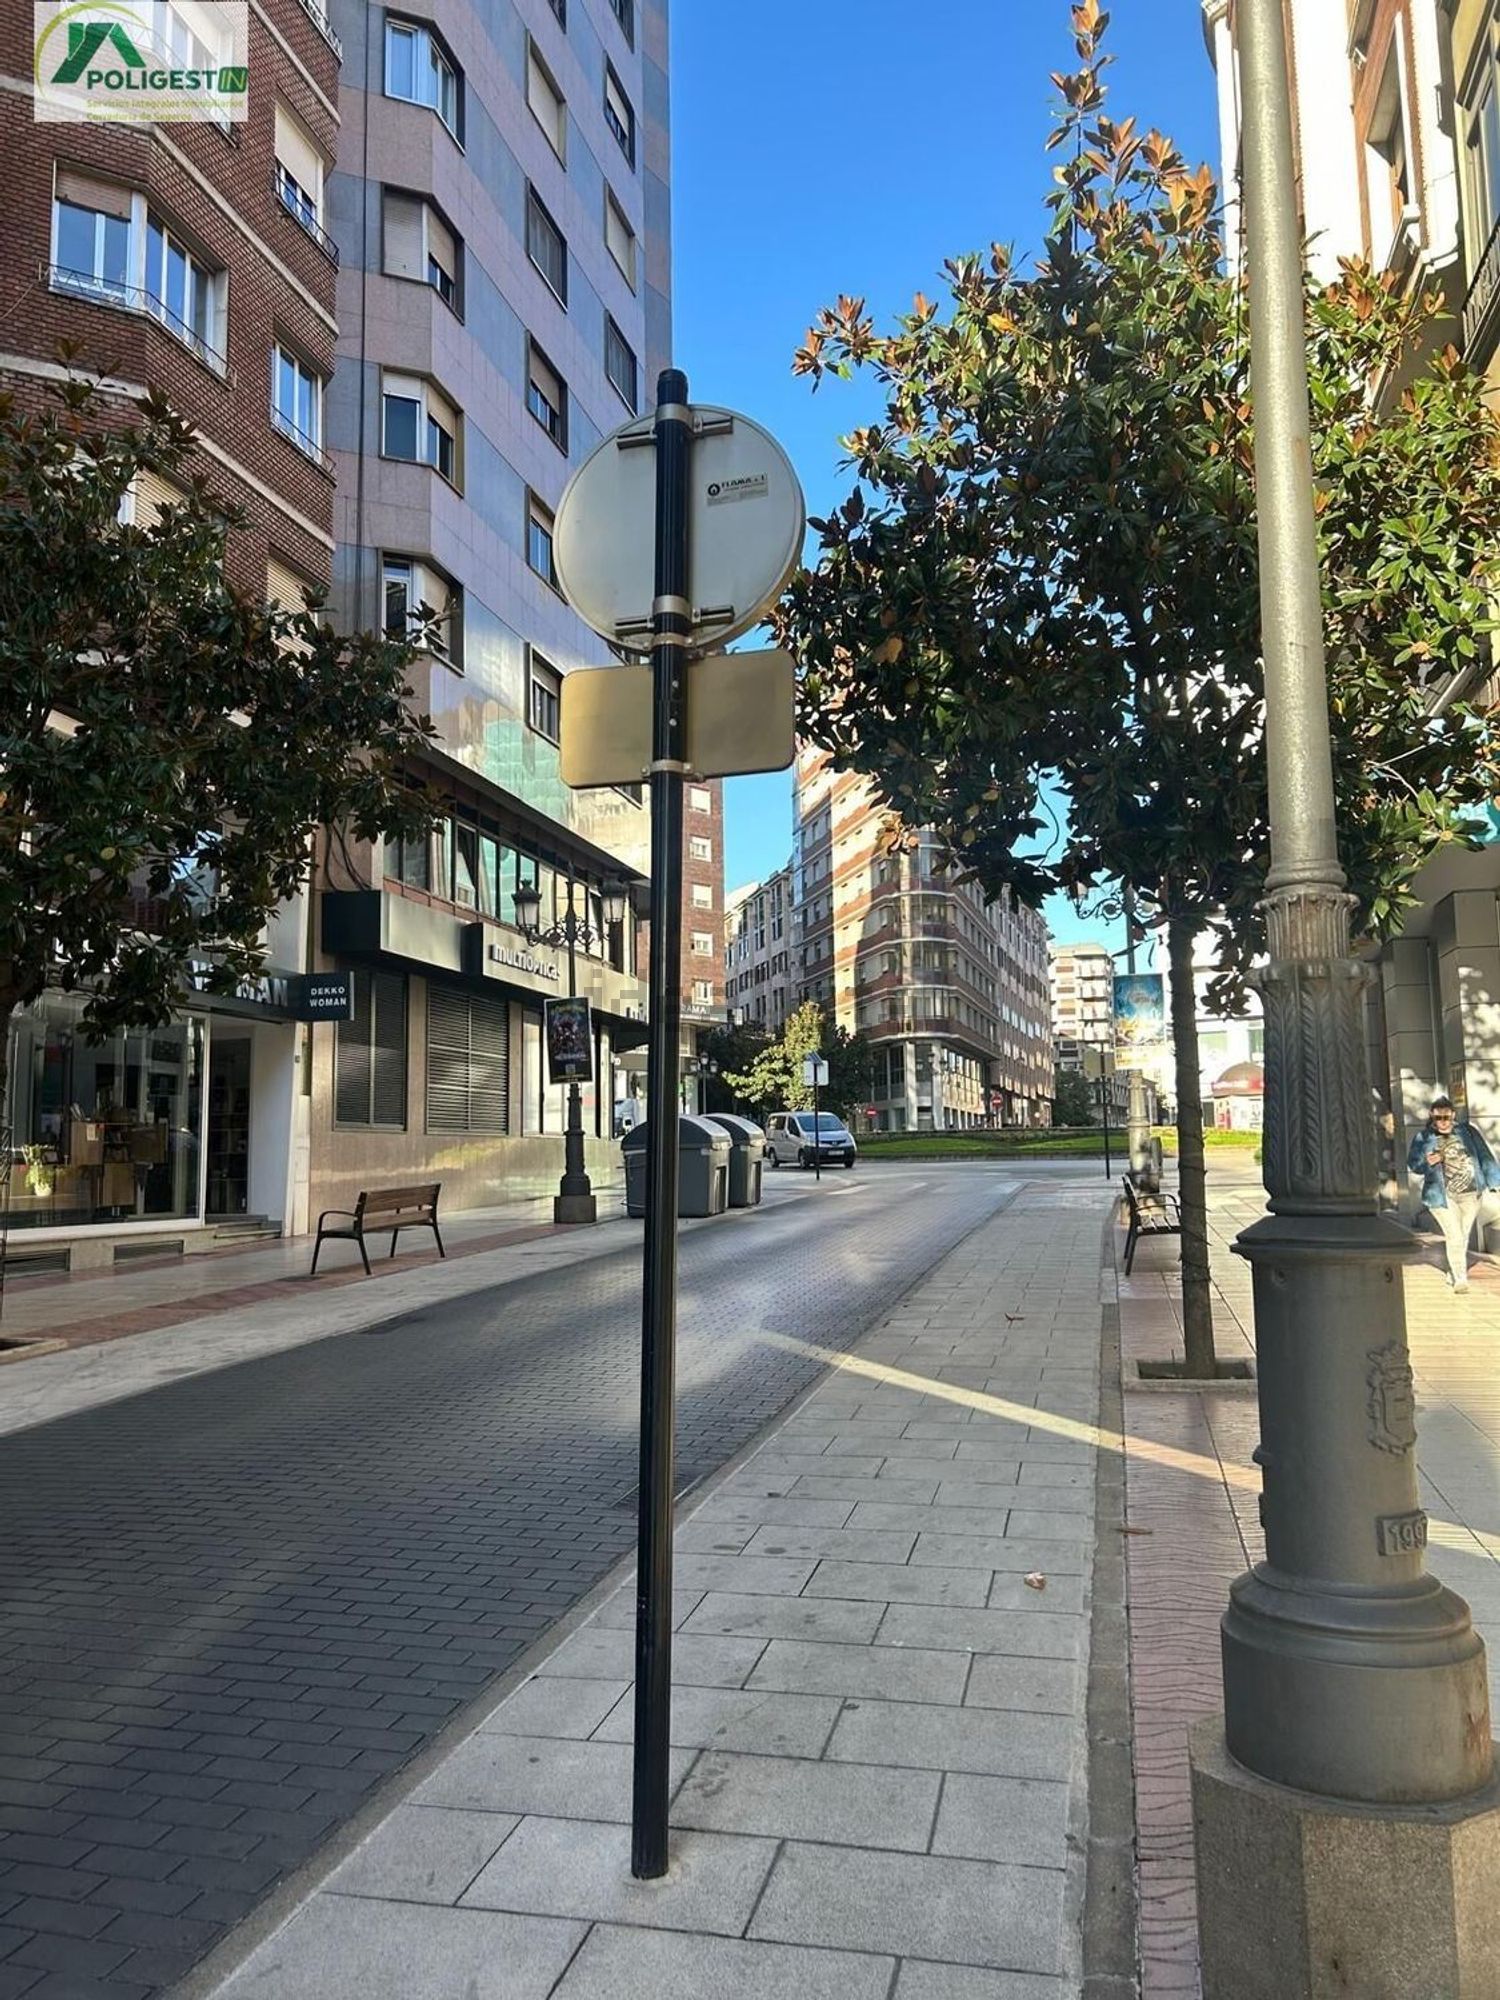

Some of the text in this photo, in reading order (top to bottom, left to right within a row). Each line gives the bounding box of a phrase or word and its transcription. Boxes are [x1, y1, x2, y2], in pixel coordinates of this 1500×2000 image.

[191, 960, 288, 1006] WMAN
[310, 986, 346, 996] DEKKO
[309, 997, 347, 1007] WOMAN
